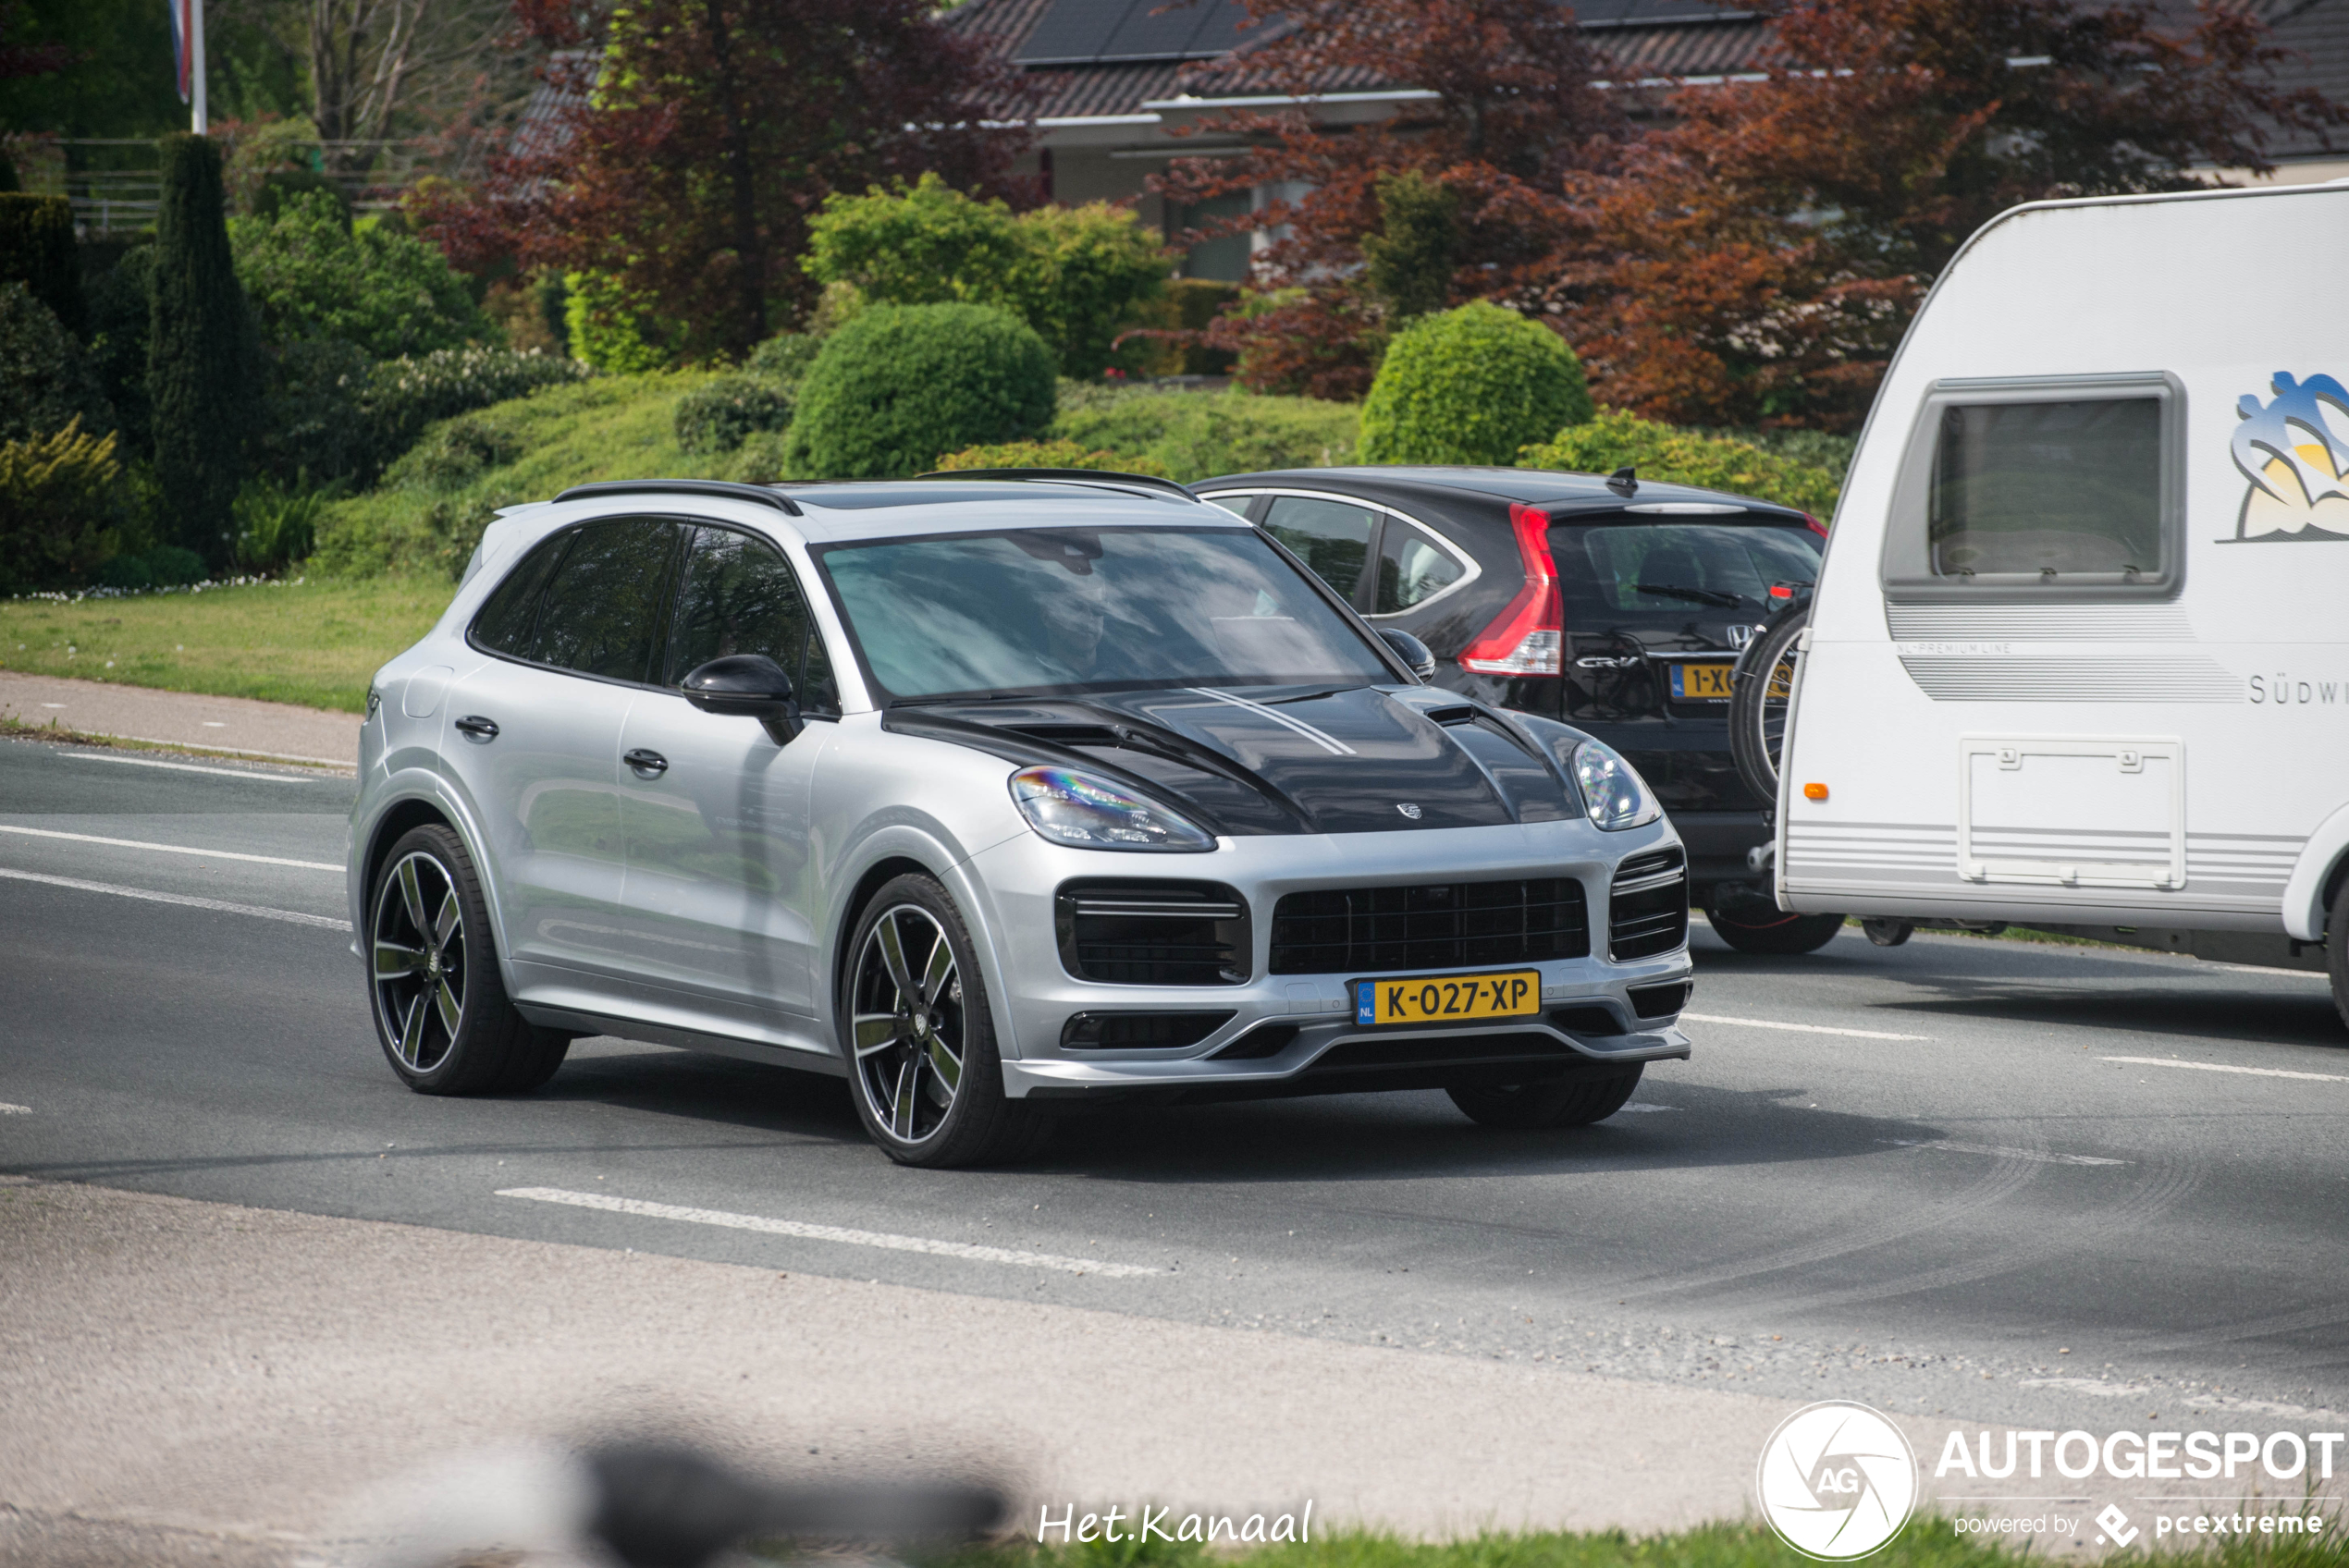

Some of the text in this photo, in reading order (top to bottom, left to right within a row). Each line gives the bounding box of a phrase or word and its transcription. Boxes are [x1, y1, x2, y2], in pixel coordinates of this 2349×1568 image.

[1897, 643, 2011, 654] NL-PREMIUM LINE
[1388, 979, 1529, 1017] K-027-XP
[1360, 1007, 1373, 1017] NL
